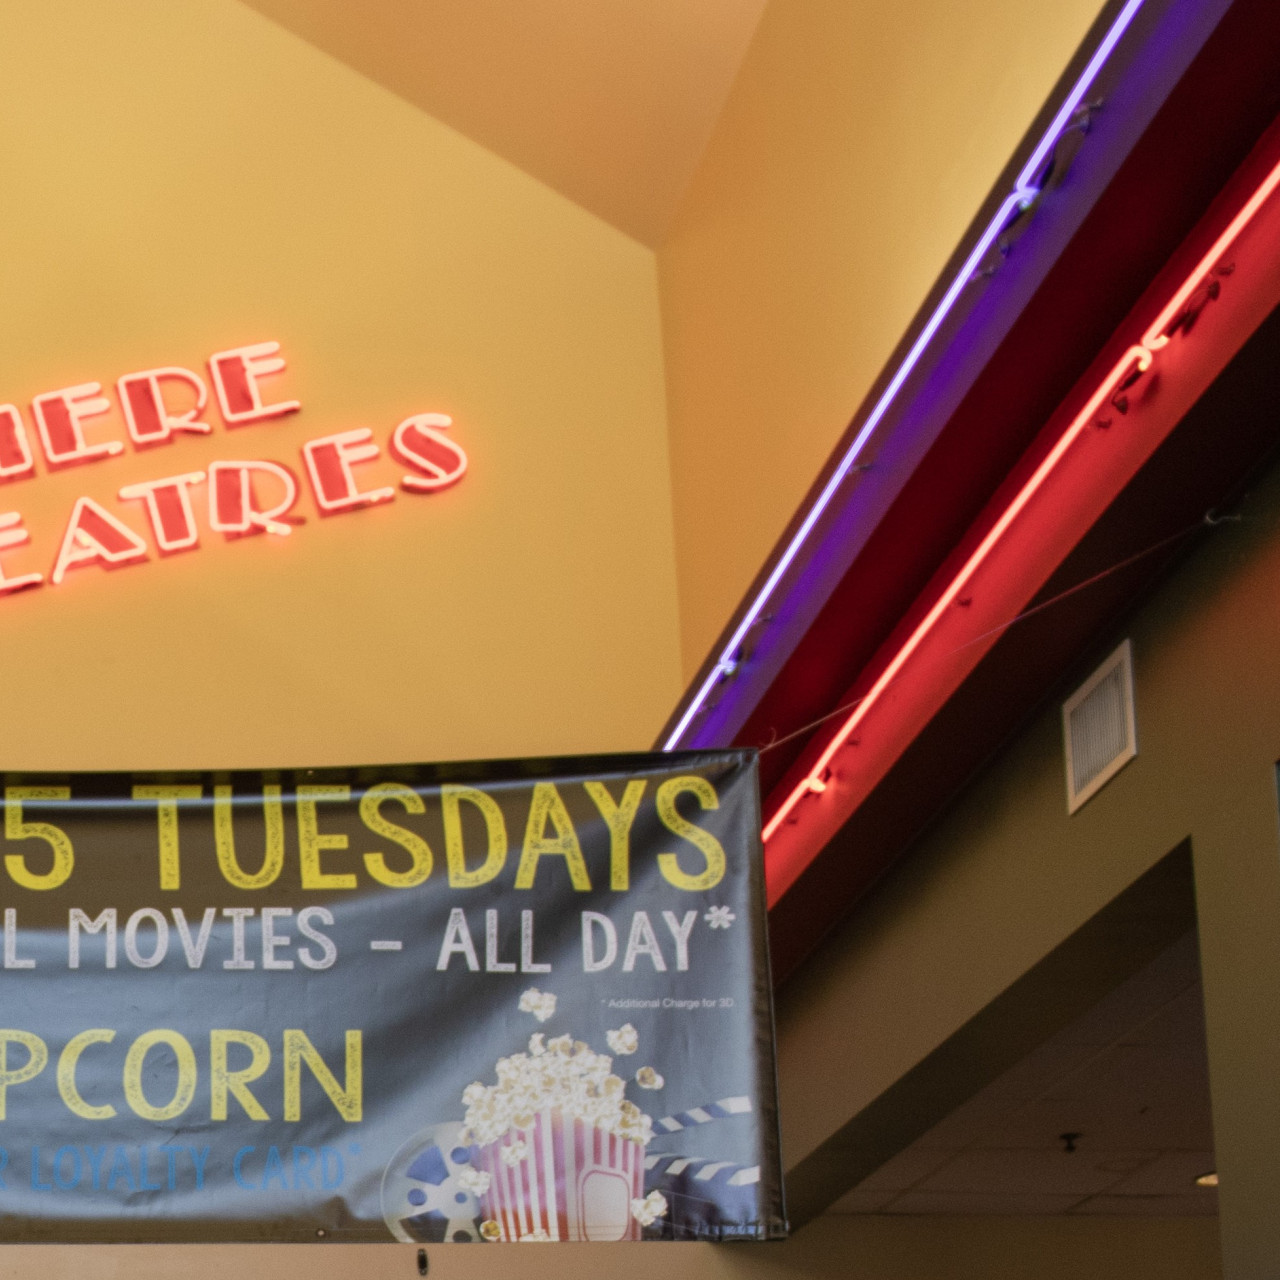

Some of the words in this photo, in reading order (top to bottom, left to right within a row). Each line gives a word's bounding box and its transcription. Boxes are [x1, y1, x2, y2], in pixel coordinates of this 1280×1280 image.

[131, 775, 728, 892] TUESDAYS
[68, 906, 337, 970] MOVIES
[435, 907, 553, 973] ALL
[608, 998, 660, 1008] Additional
[663, 998, 700, 1010] Charge
[702, 998, 716, 1008] for
[718, 998, 734, 1007] 3D
[31, 1145, 212, 1194] LOYALTY
